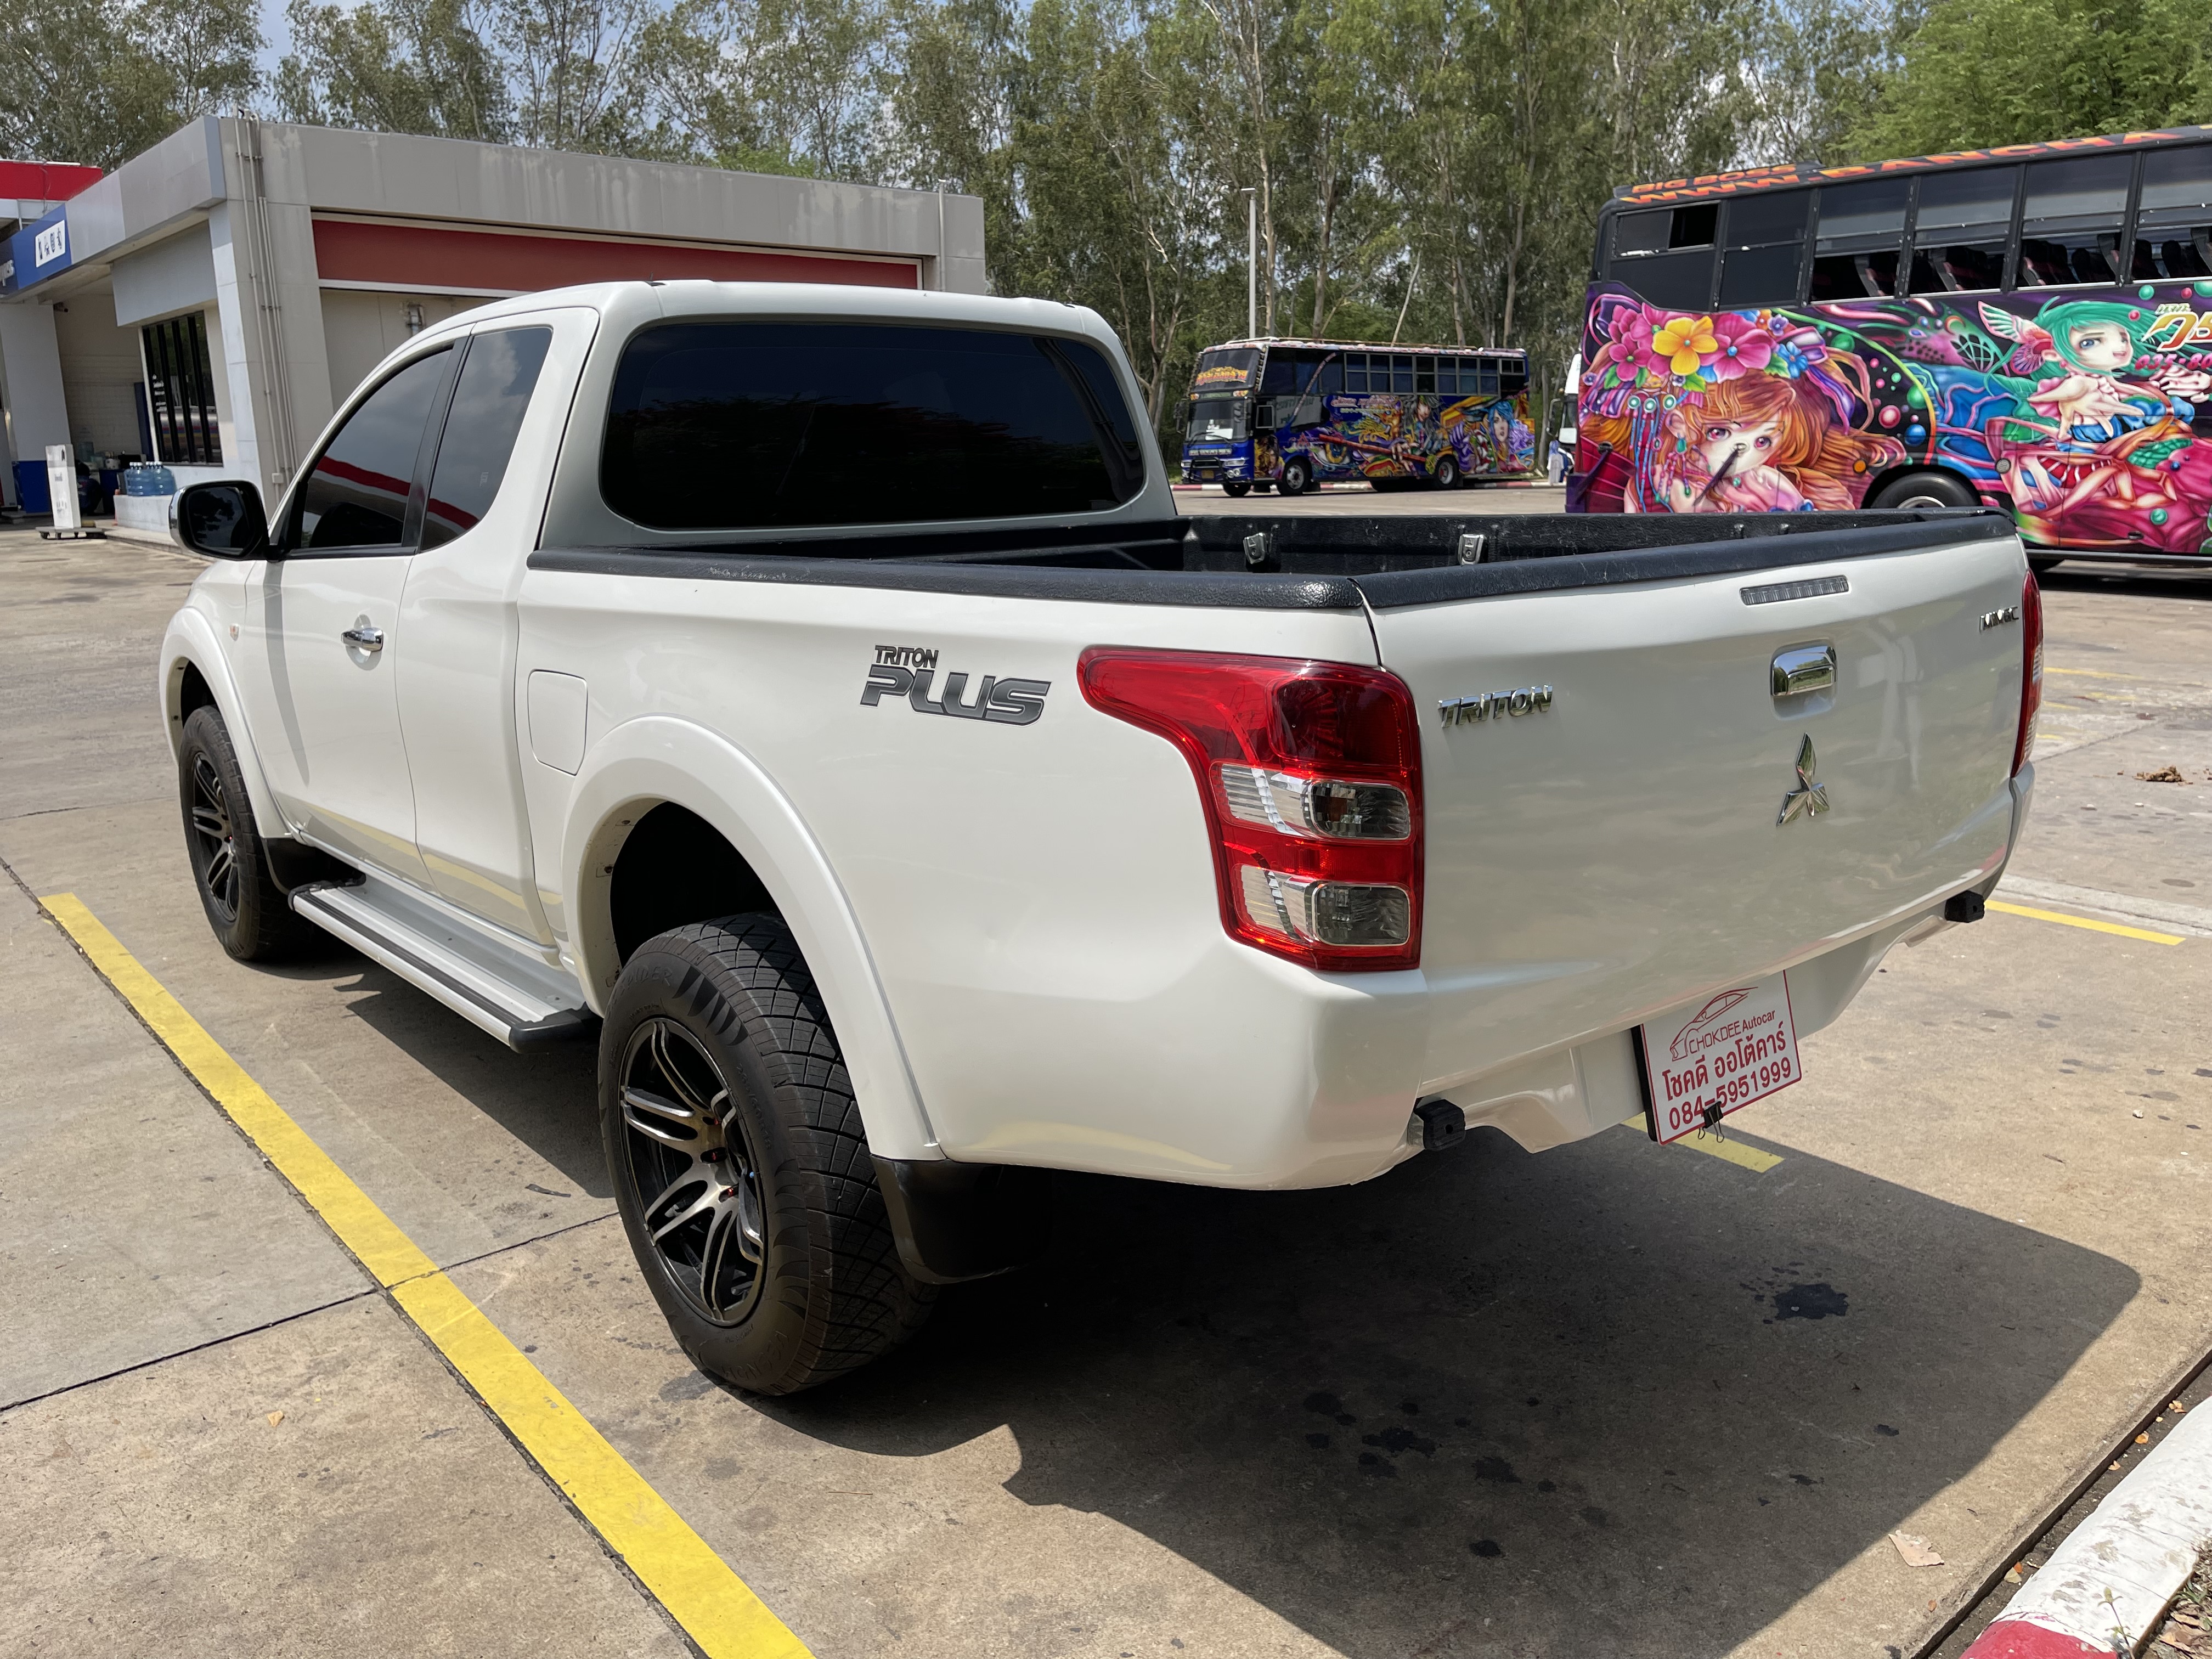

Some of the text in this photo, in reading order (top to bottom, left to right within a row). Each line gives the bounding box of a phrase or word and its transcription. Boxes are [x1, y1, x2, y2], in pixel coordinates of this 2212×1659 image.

[1632, 163, 1797, 193] BIG BOSS
[875, 645, 939, 668] TRITON
[860, 664, 1052, 726] PLUS
[1437, 685, 1553, 728] TRITON
[1689, 1010, 1775, 1054] CHOKDEE Autocar
[1662, 1020, 1786, 1101] โชคดี ออโต้คาร์
[1669, 1057, 1791, 1130] 084-5951999
